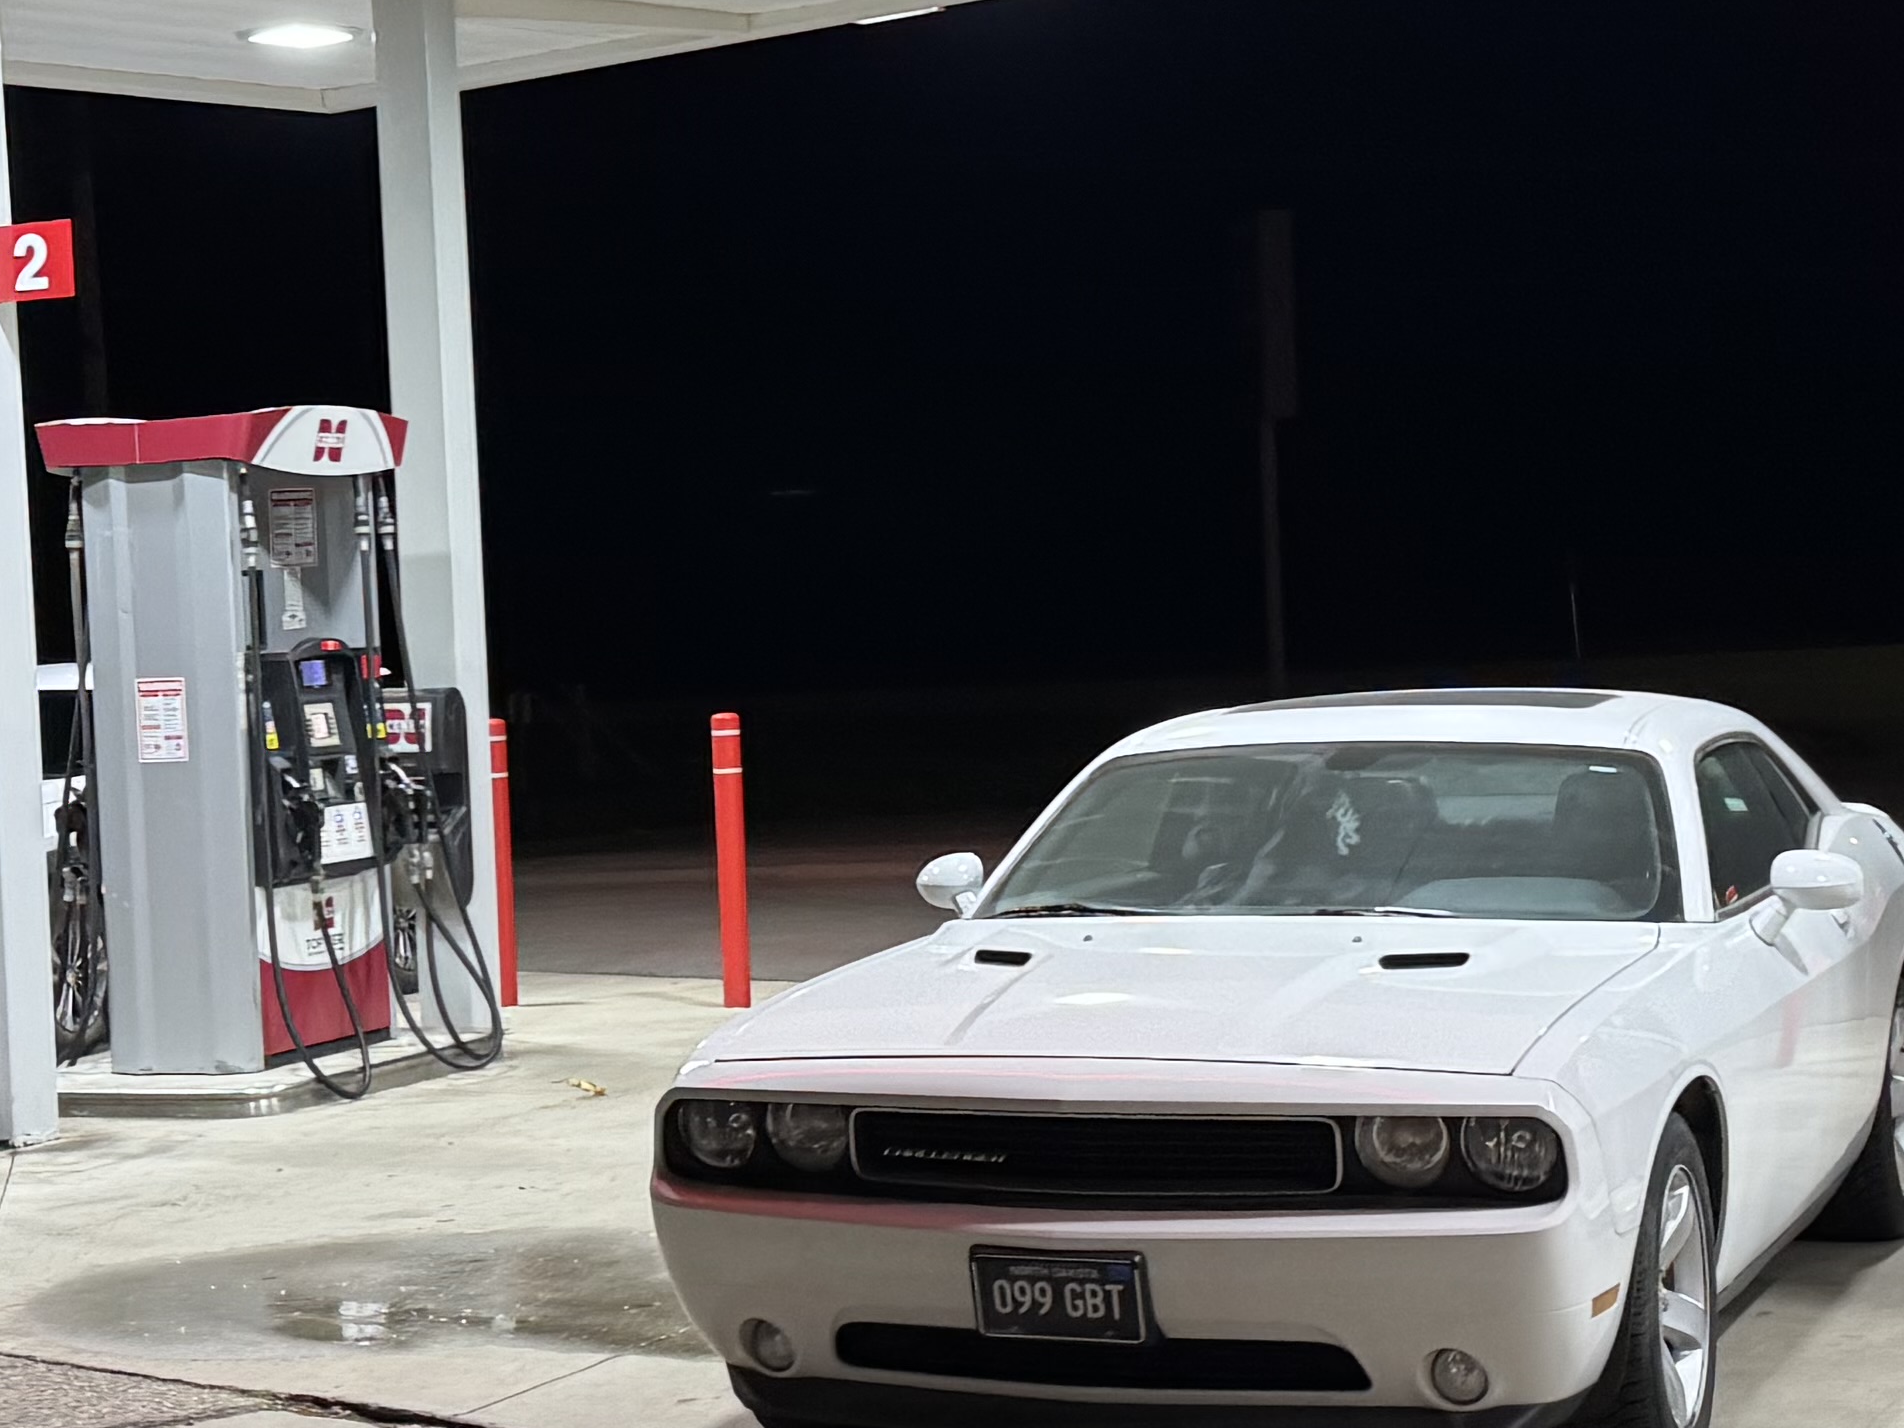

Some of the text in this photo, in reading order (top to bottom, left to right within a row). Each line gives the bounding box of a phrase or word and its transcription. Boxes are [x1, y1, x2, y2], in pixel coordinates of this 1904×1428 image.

[13, 233, 50, 292] 2
[992, 1279, 1124, 1321] 099 GBT
